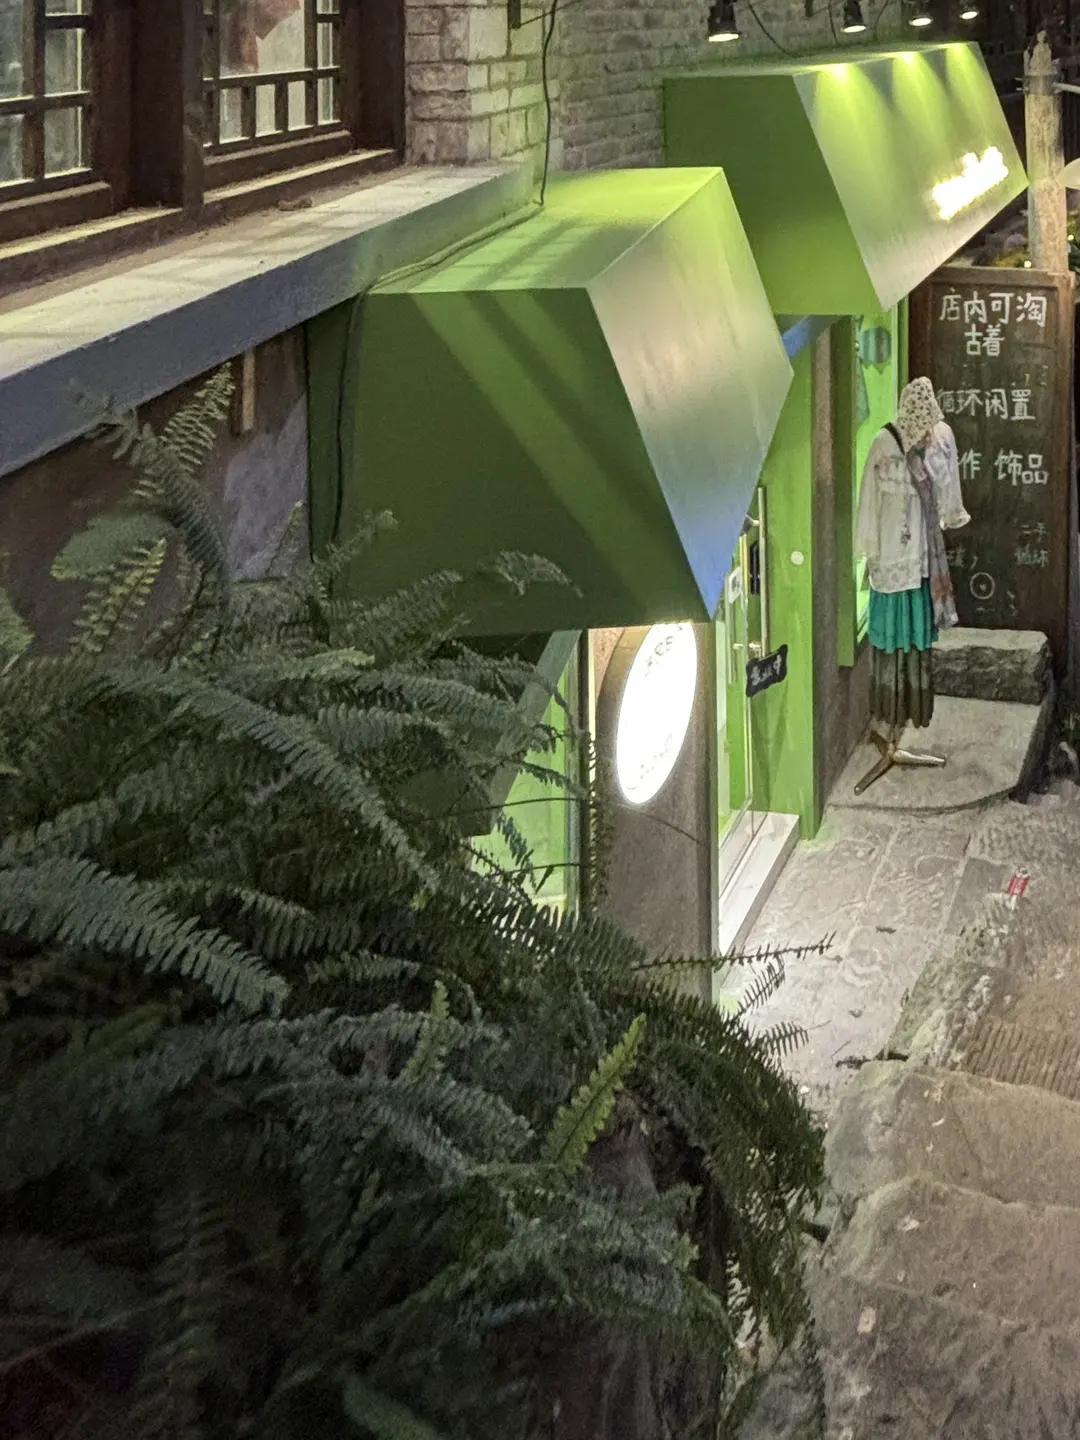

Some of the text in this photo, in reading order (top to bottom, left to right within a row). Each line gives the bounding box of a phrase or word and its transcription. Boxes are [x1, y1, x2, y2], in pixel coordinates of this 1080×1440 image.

[939, 287, 1047, 327] 店内可淘
[964, 323, 1005, 356] 古着
[994, 449, 1048, 486] 饰品
